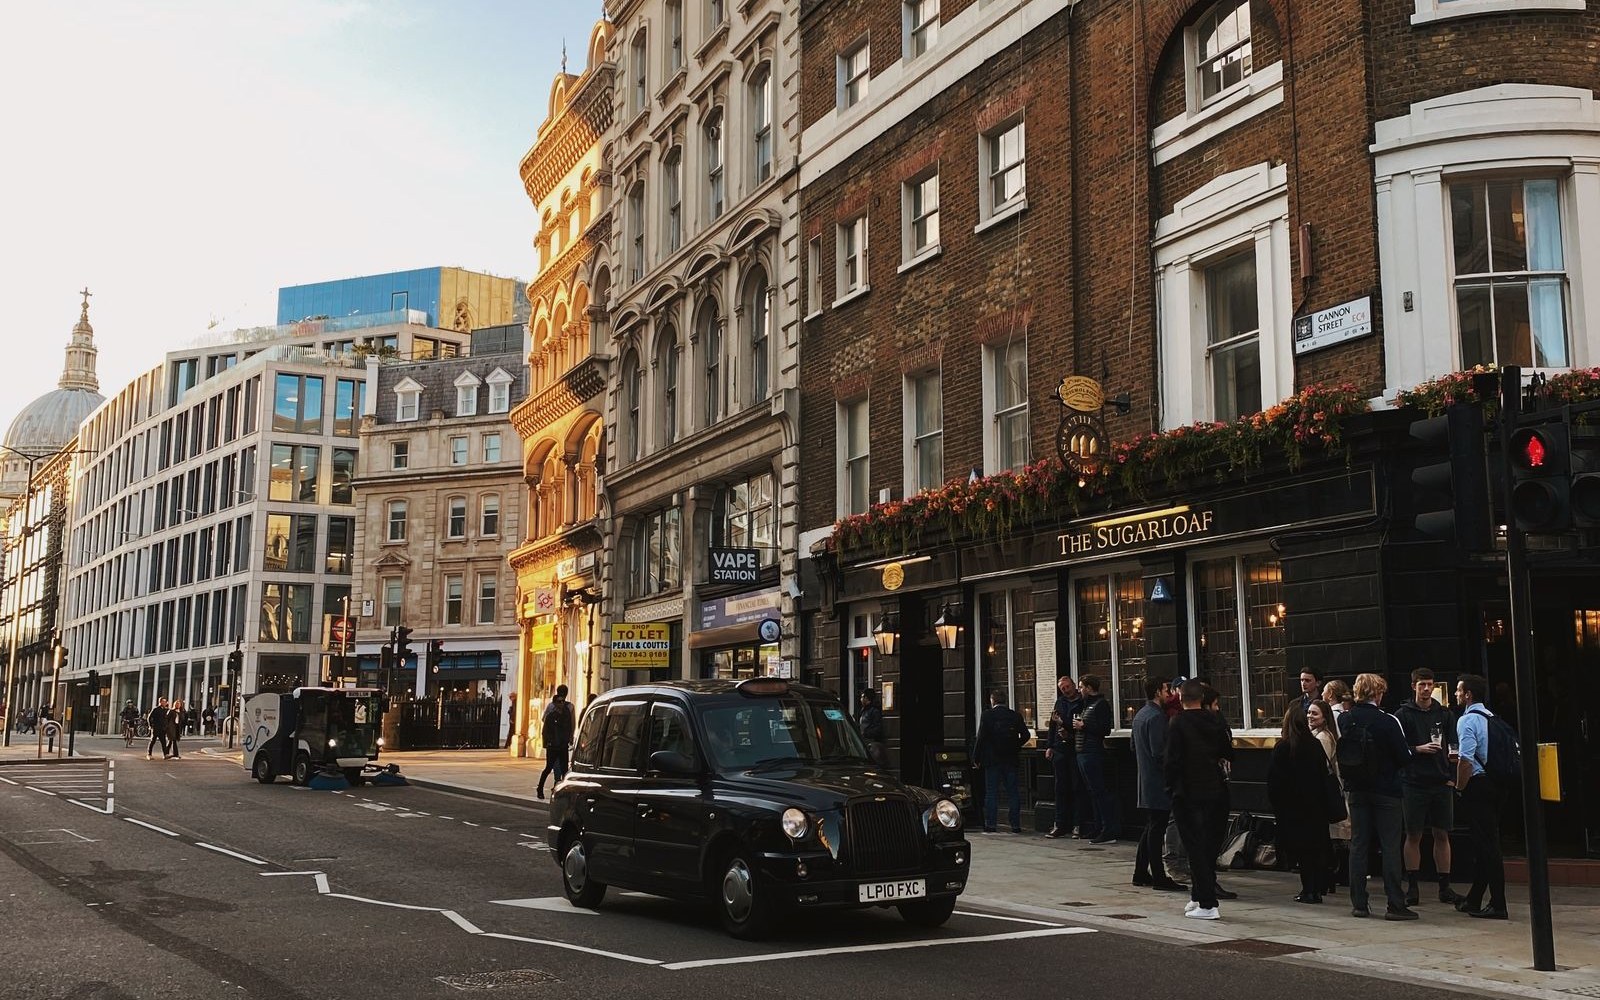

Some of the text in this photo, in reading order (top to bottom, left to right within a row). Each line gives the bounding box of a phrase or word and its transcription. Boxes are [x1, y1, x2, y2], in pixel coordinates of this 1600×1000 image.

[1318, 306, 1351, 323] CANNON
[1352, 312, 1365, 323] EC4
[1318, 318, 1344, 333] STREET
[1056, 510, 1214, 556] THE SUGARLOAF
[713, 552, 756, 569] VAPE
[713, 569, 756, 581] STATION
[617, 630, 665, 640] TO LET
[612, 641, 668, 649] PEARL & COUTTS
[867, 881, 919, 899] LP10 FXC
